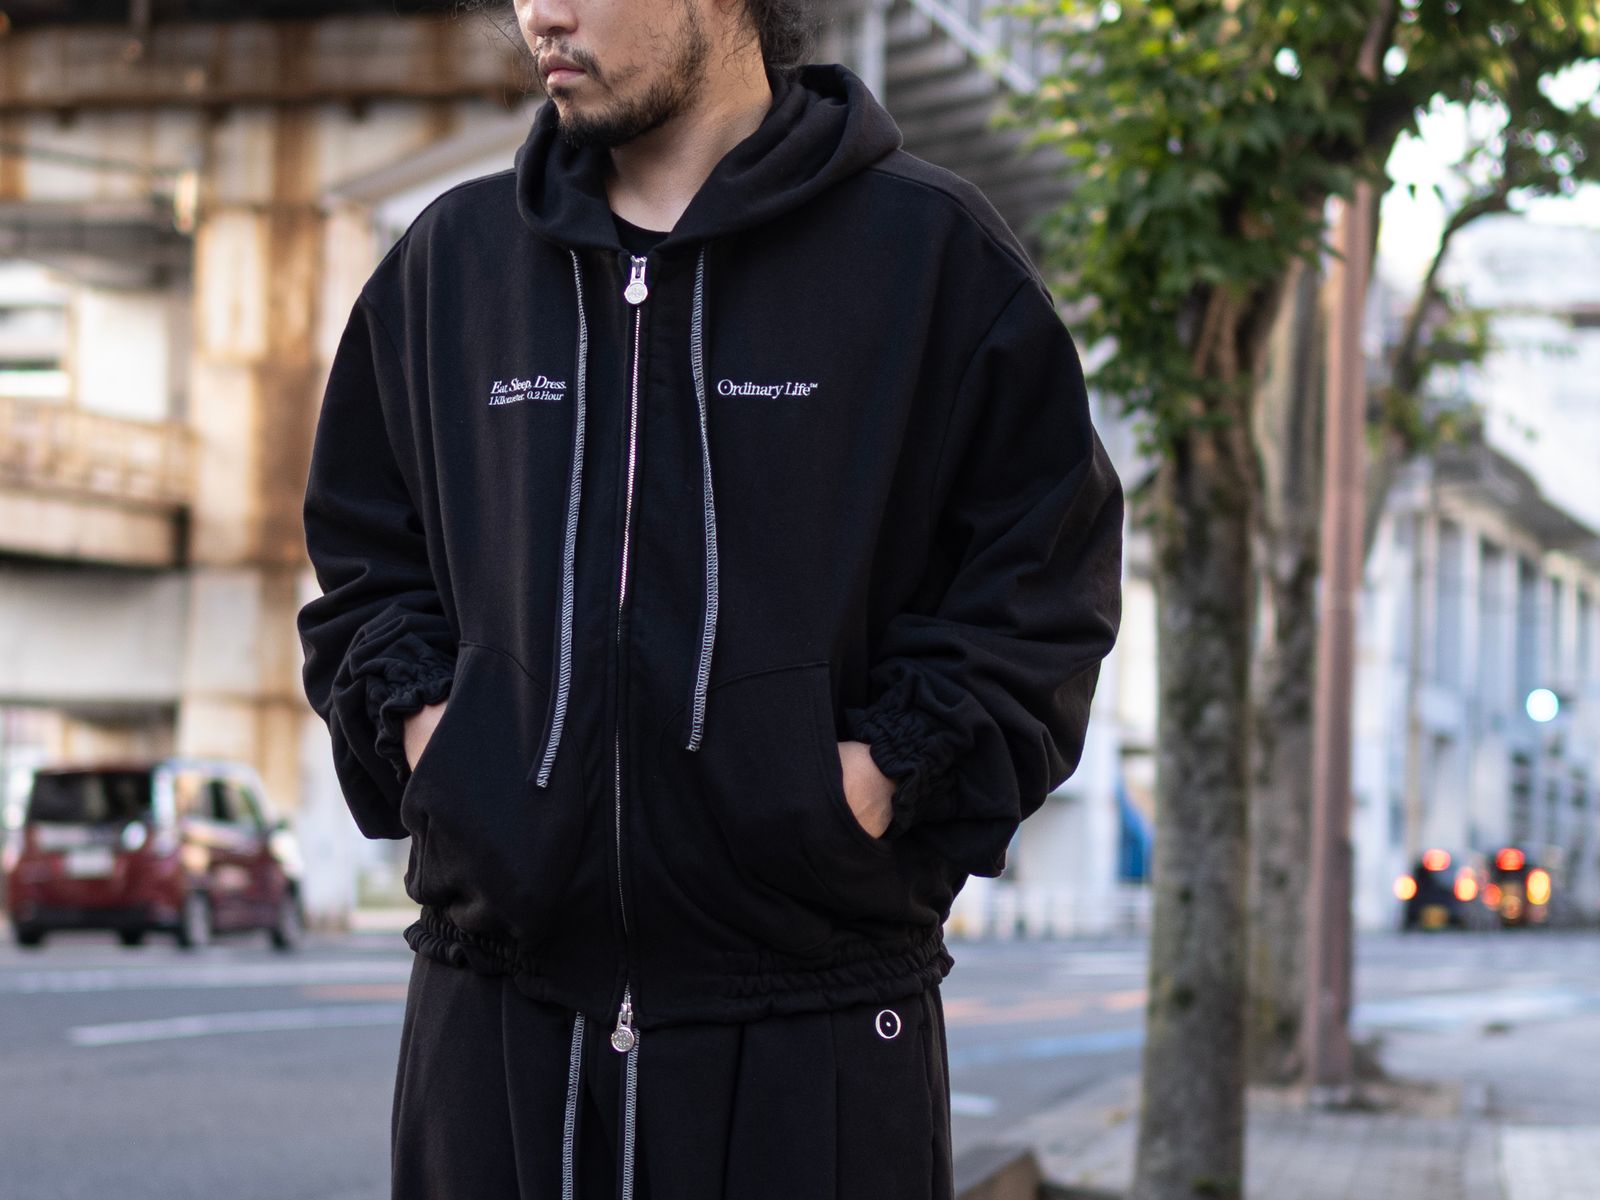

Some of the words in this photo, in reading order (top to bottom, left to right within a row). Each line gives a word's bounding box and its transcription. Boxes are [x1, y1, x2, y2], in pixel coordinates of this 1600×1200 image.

[533, 375, 567, 389] Dress.
[718, 378, 784, 399] Ordinary
[526, 391, 540, 400] 0.2
[540, 391, 564, 400] Hour
